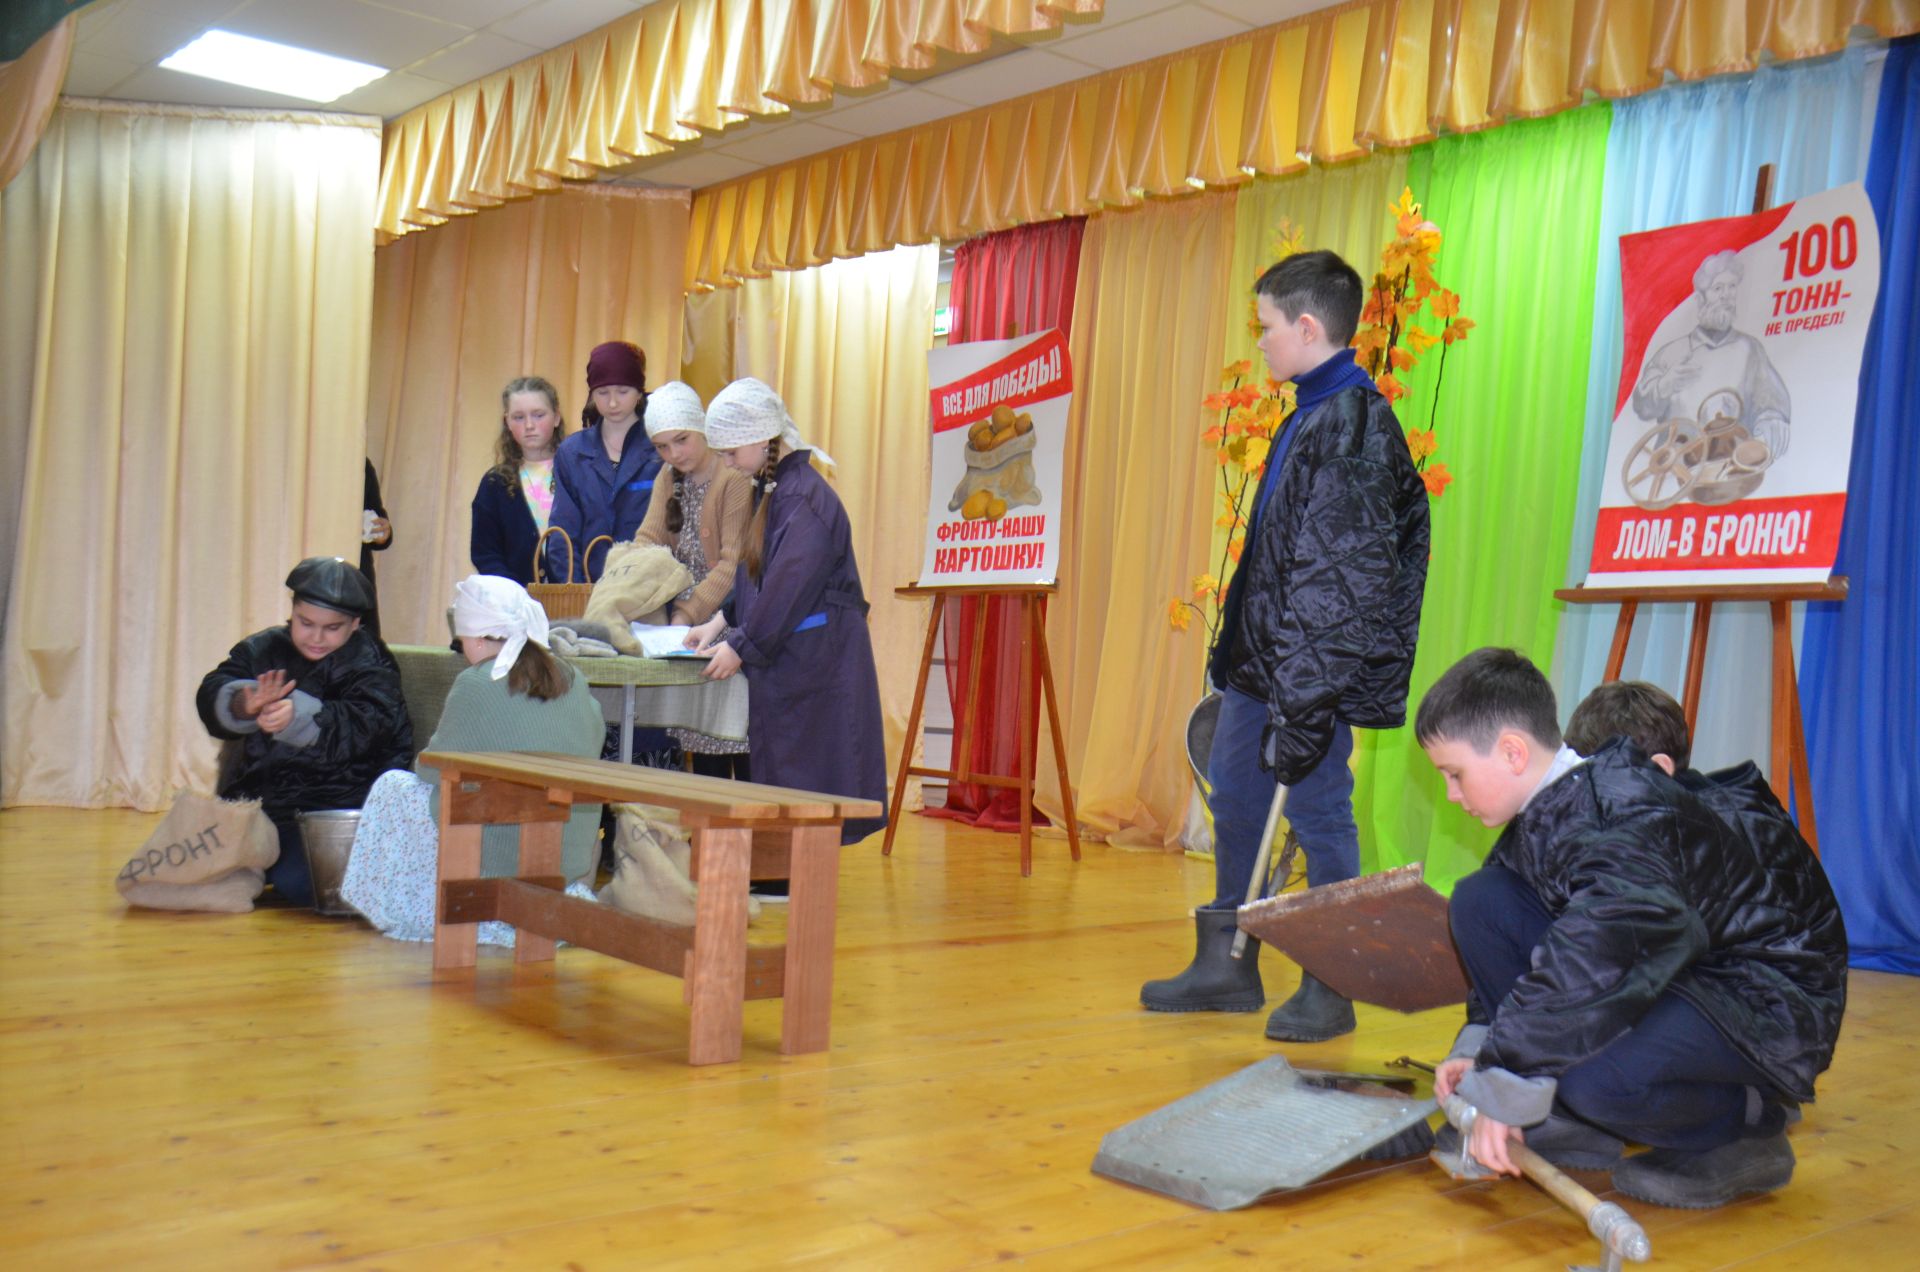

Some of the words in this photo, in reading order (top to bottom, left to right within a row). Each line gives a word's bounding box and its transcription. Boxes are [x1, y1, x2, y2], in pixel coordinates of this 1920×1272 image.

[1779, 214, 1858, 282] 100
[1772, 279, 1852, 317] ТОНН-
[1764, 321, 1783, 337] НЕ
[1785, 311, 1845, 333] ПРЕДЕЛ!
[942, 391, 963, 417] ВСЕ
[964, 382, 990, 416] ДЛЯ
[991, 344, 1061, 403] ПОБЕДЫ!
[936, 514, 1046, 542] ФРОНТУ-НАШУ
[1612, 517, 1696, 559] ЛОМ-В
[1701, 509, 1811, 556] БРОНЮ!
[933, 542, 1045, 574] КАРТОШКУ!
[119, 822, 224, 882] ФРОНТ
